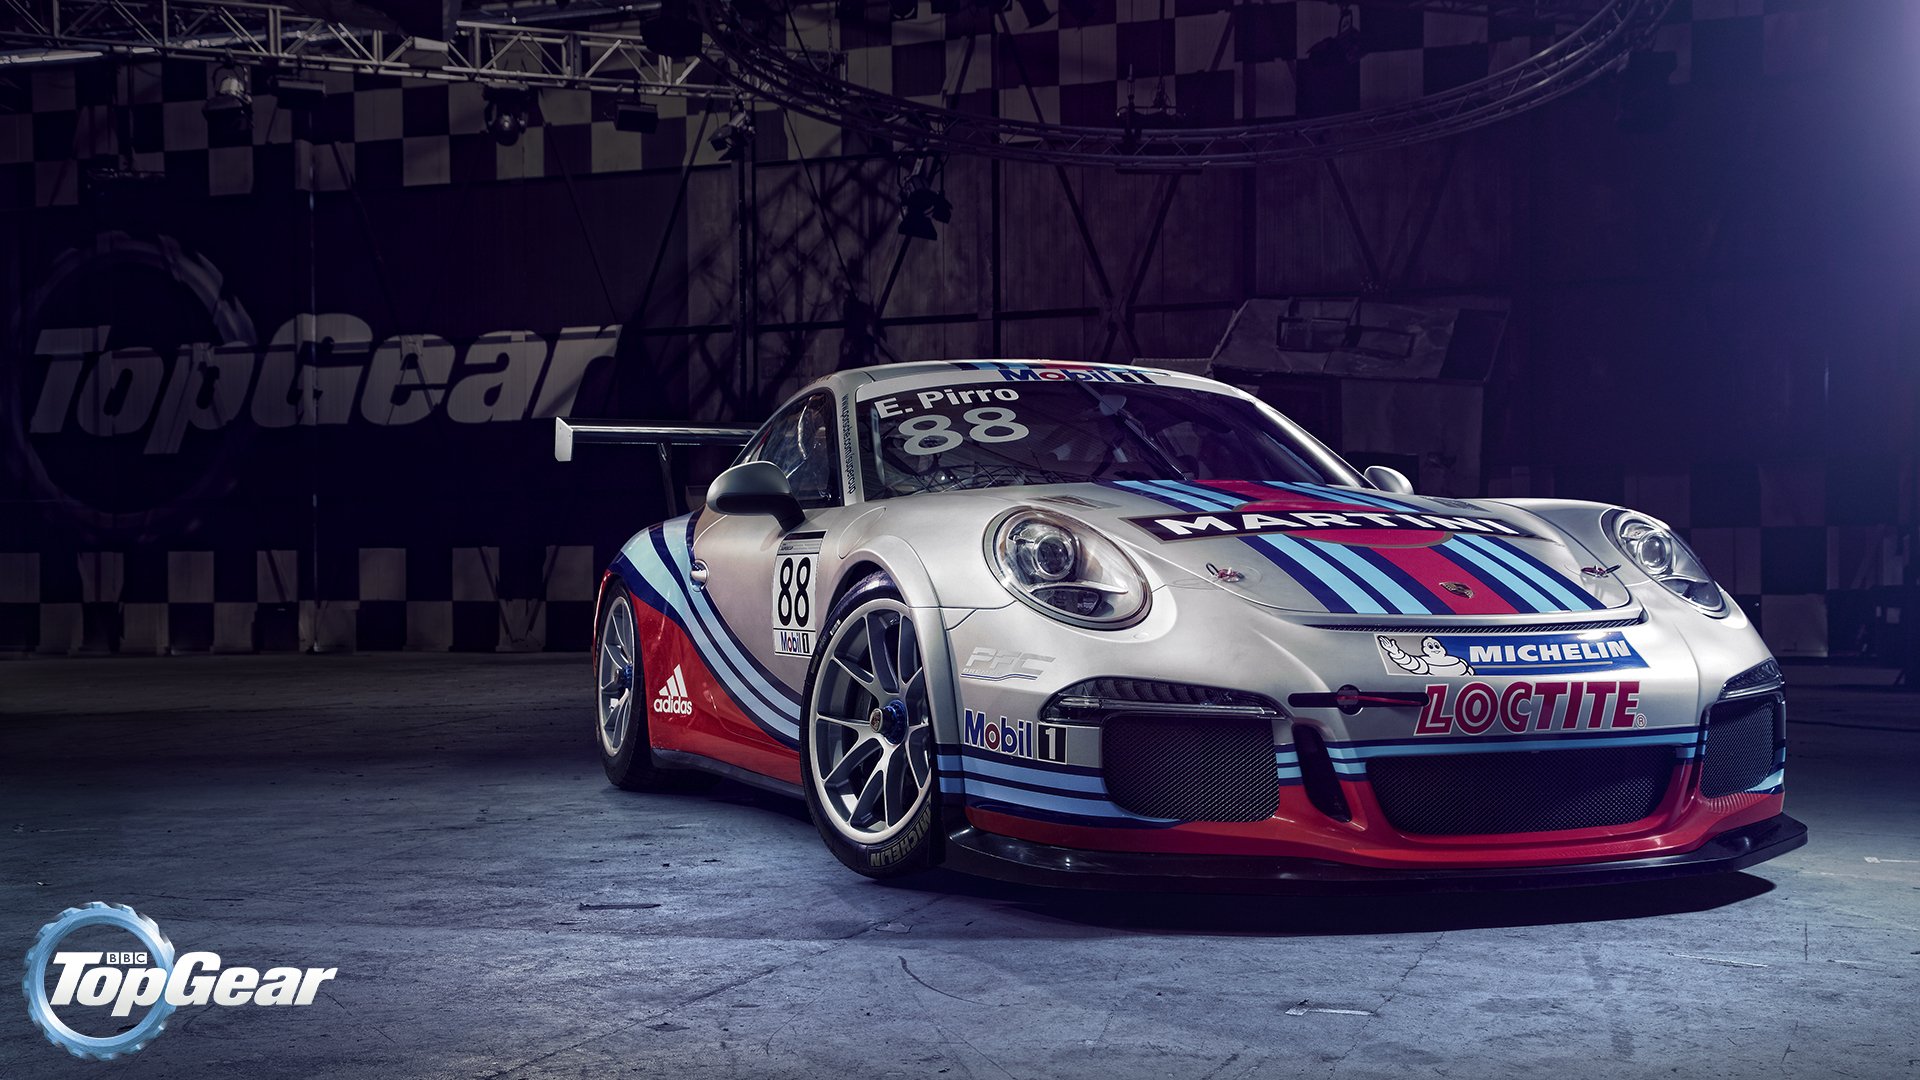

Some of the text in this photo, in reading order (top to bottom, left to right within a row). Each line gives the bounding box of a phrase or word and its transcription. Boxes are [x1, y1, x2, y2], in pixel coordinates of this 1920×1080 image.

[998, 369, 1116, 381] Mobil
[874, 388, 1020, 419] E. Pirro
[898, 406, 1030, 456] 88
[1154, 512, 1520, 536] MARTINI
[778, 556, 811, 628] 88
[780, 631, 802, 653] Mobil
[802, 632, 810, 653] 1
[1468, 640, 1632, 663] MICHELIN
[965, 646, 1056, 675] PFC
[653, 695, 693, 715] adidas
[1414, 681, 1641, 737] LOCTITE
[964, 708, 1059, 761] Mobil 1
[870, 804, 932, 867] MICHELIN
